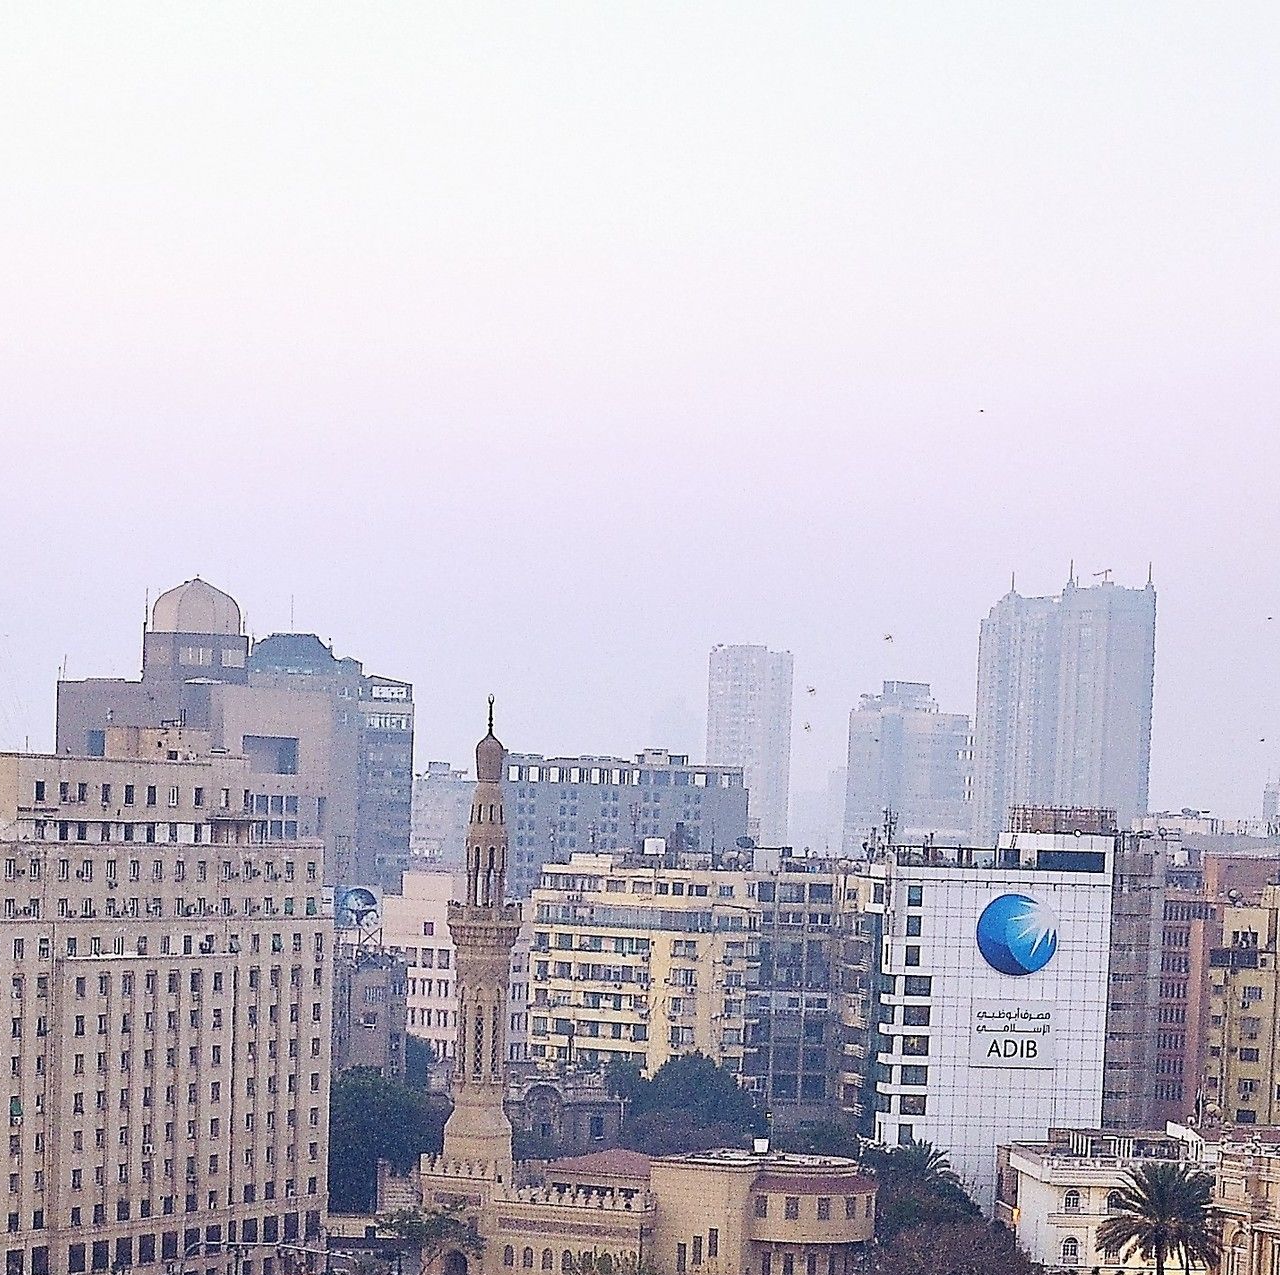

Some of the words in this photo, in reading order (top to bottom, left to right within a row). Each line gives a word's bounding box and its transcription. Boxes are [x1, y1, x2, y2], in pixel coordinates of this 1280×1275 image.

[1020, 1008, 1051, 1022] مصرف
[975, 1022, 1051, 1037] الإسلامي
[986, 1038, 1038, 1059] ADIB
